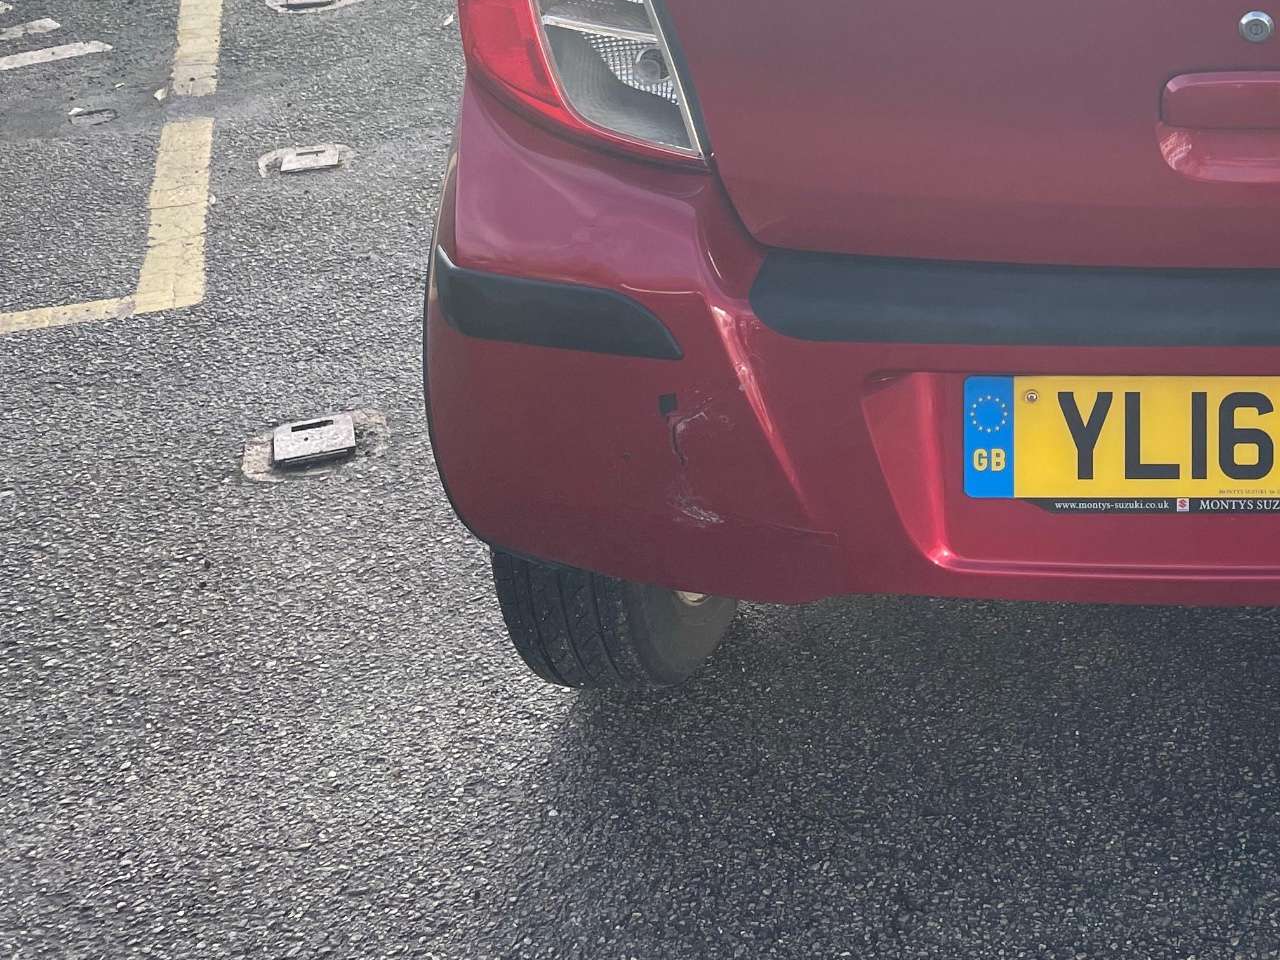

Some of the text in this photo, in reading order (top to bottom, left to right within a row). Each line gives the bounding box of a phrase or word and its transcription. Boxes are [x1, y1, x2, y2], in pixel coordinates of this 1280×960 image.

[1057, 391, 1275, 481] YL16
[973, 448, 1006, 472] GB
[1055, 501, 1170, 512] www.montys-suzuki.co.uk
[1200, 500, 1253, 511] MONTYS
